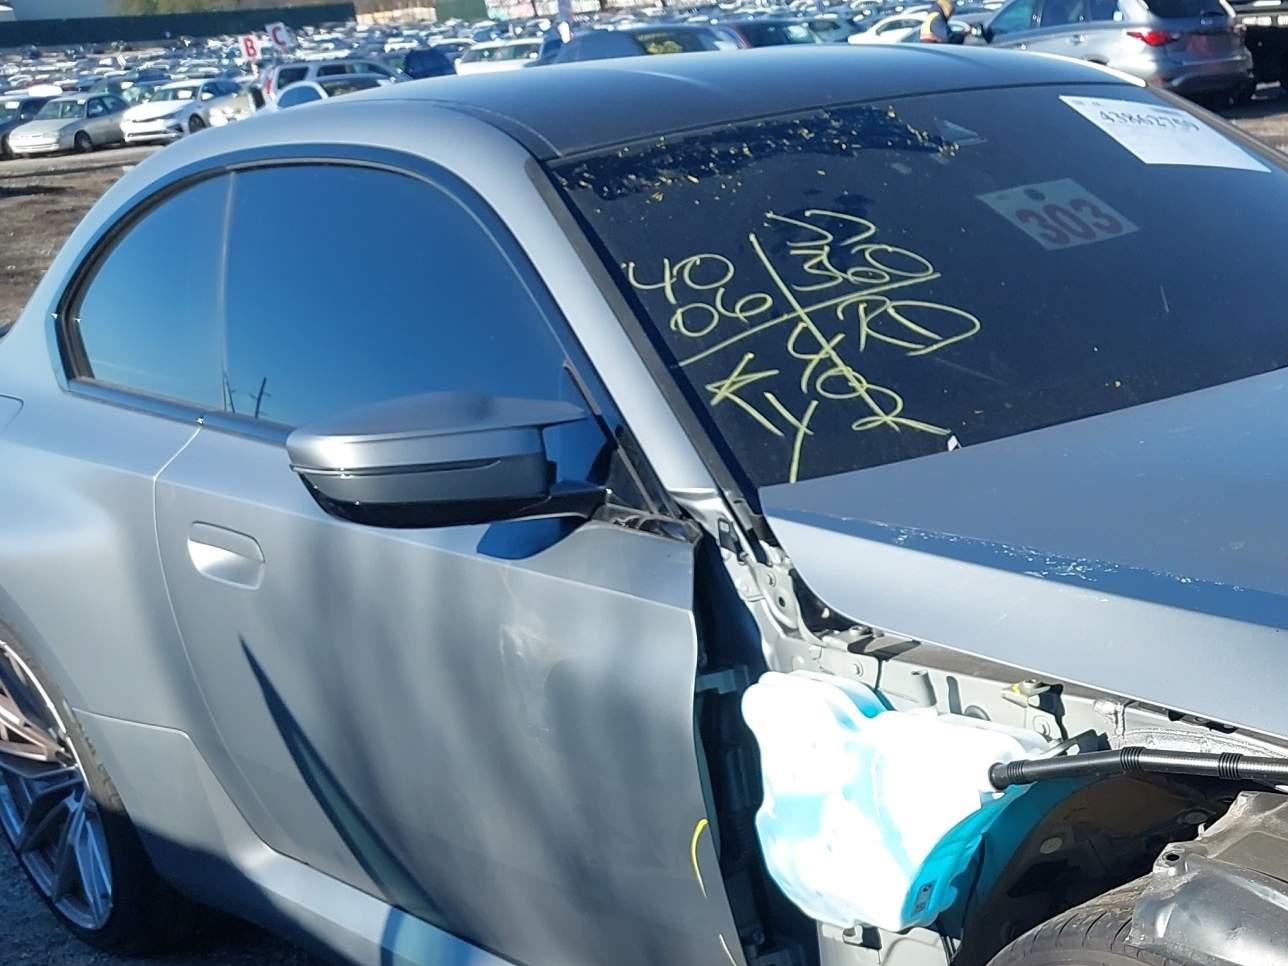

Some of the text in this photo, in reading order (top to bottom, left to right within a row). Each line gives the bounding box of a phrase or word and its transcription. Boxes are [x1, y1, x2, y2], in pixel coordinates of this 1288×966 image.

[271, 26, 288, 46] C
[243, 37, 257, 57] B
[1015, 198, 1123, 245] 303
